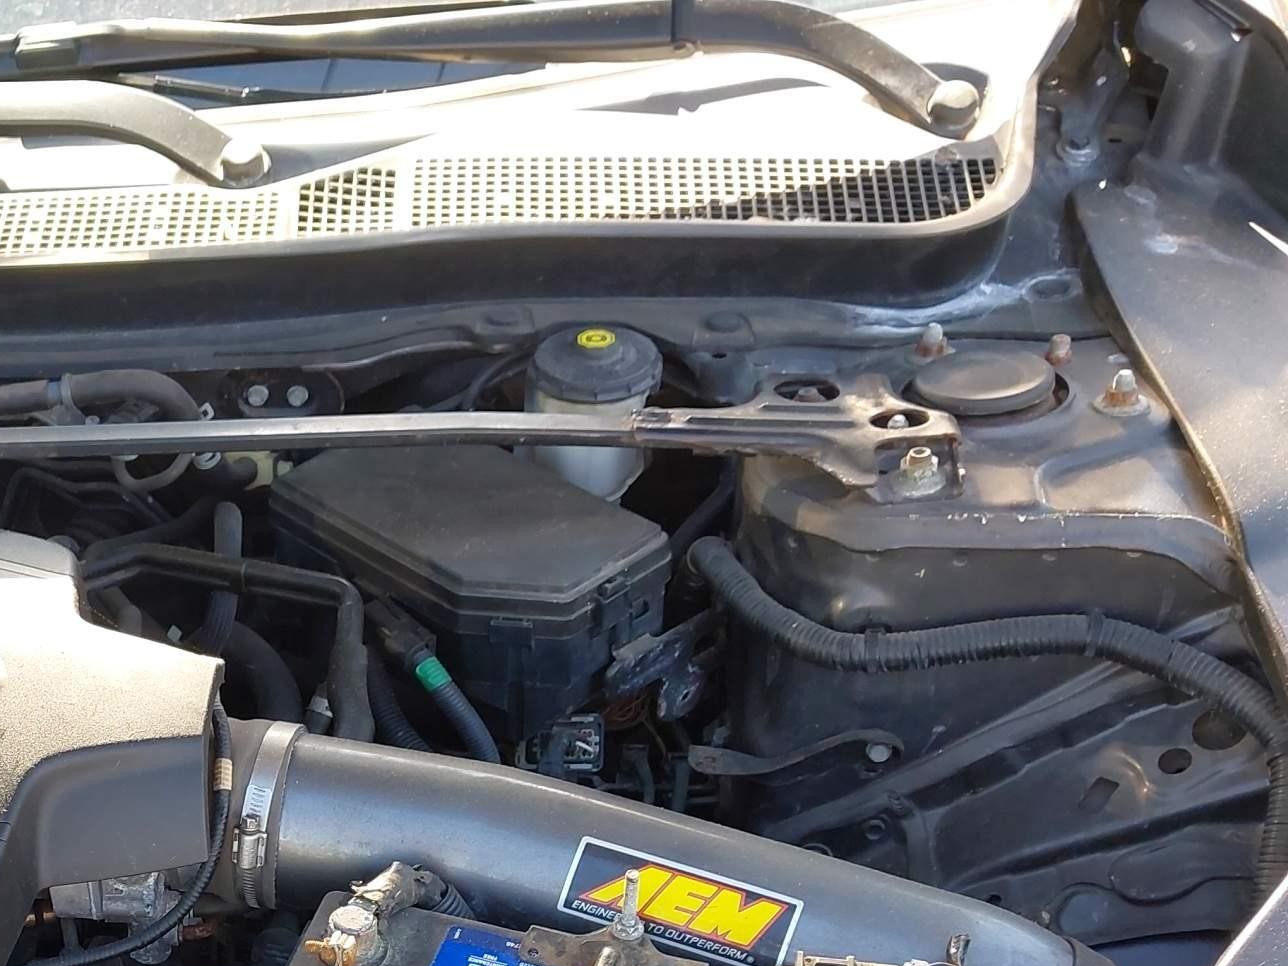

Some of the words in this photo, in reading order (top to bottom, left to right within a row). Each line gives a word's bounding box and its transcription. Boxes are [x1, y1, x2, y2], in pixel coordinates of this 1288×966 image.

[580, 863, 789, 950] AEM
[482, 952, 498, 960] FREE
[647, 922, 664, 935] TO
[665, 928, 748, 962] OUTPERFORM
